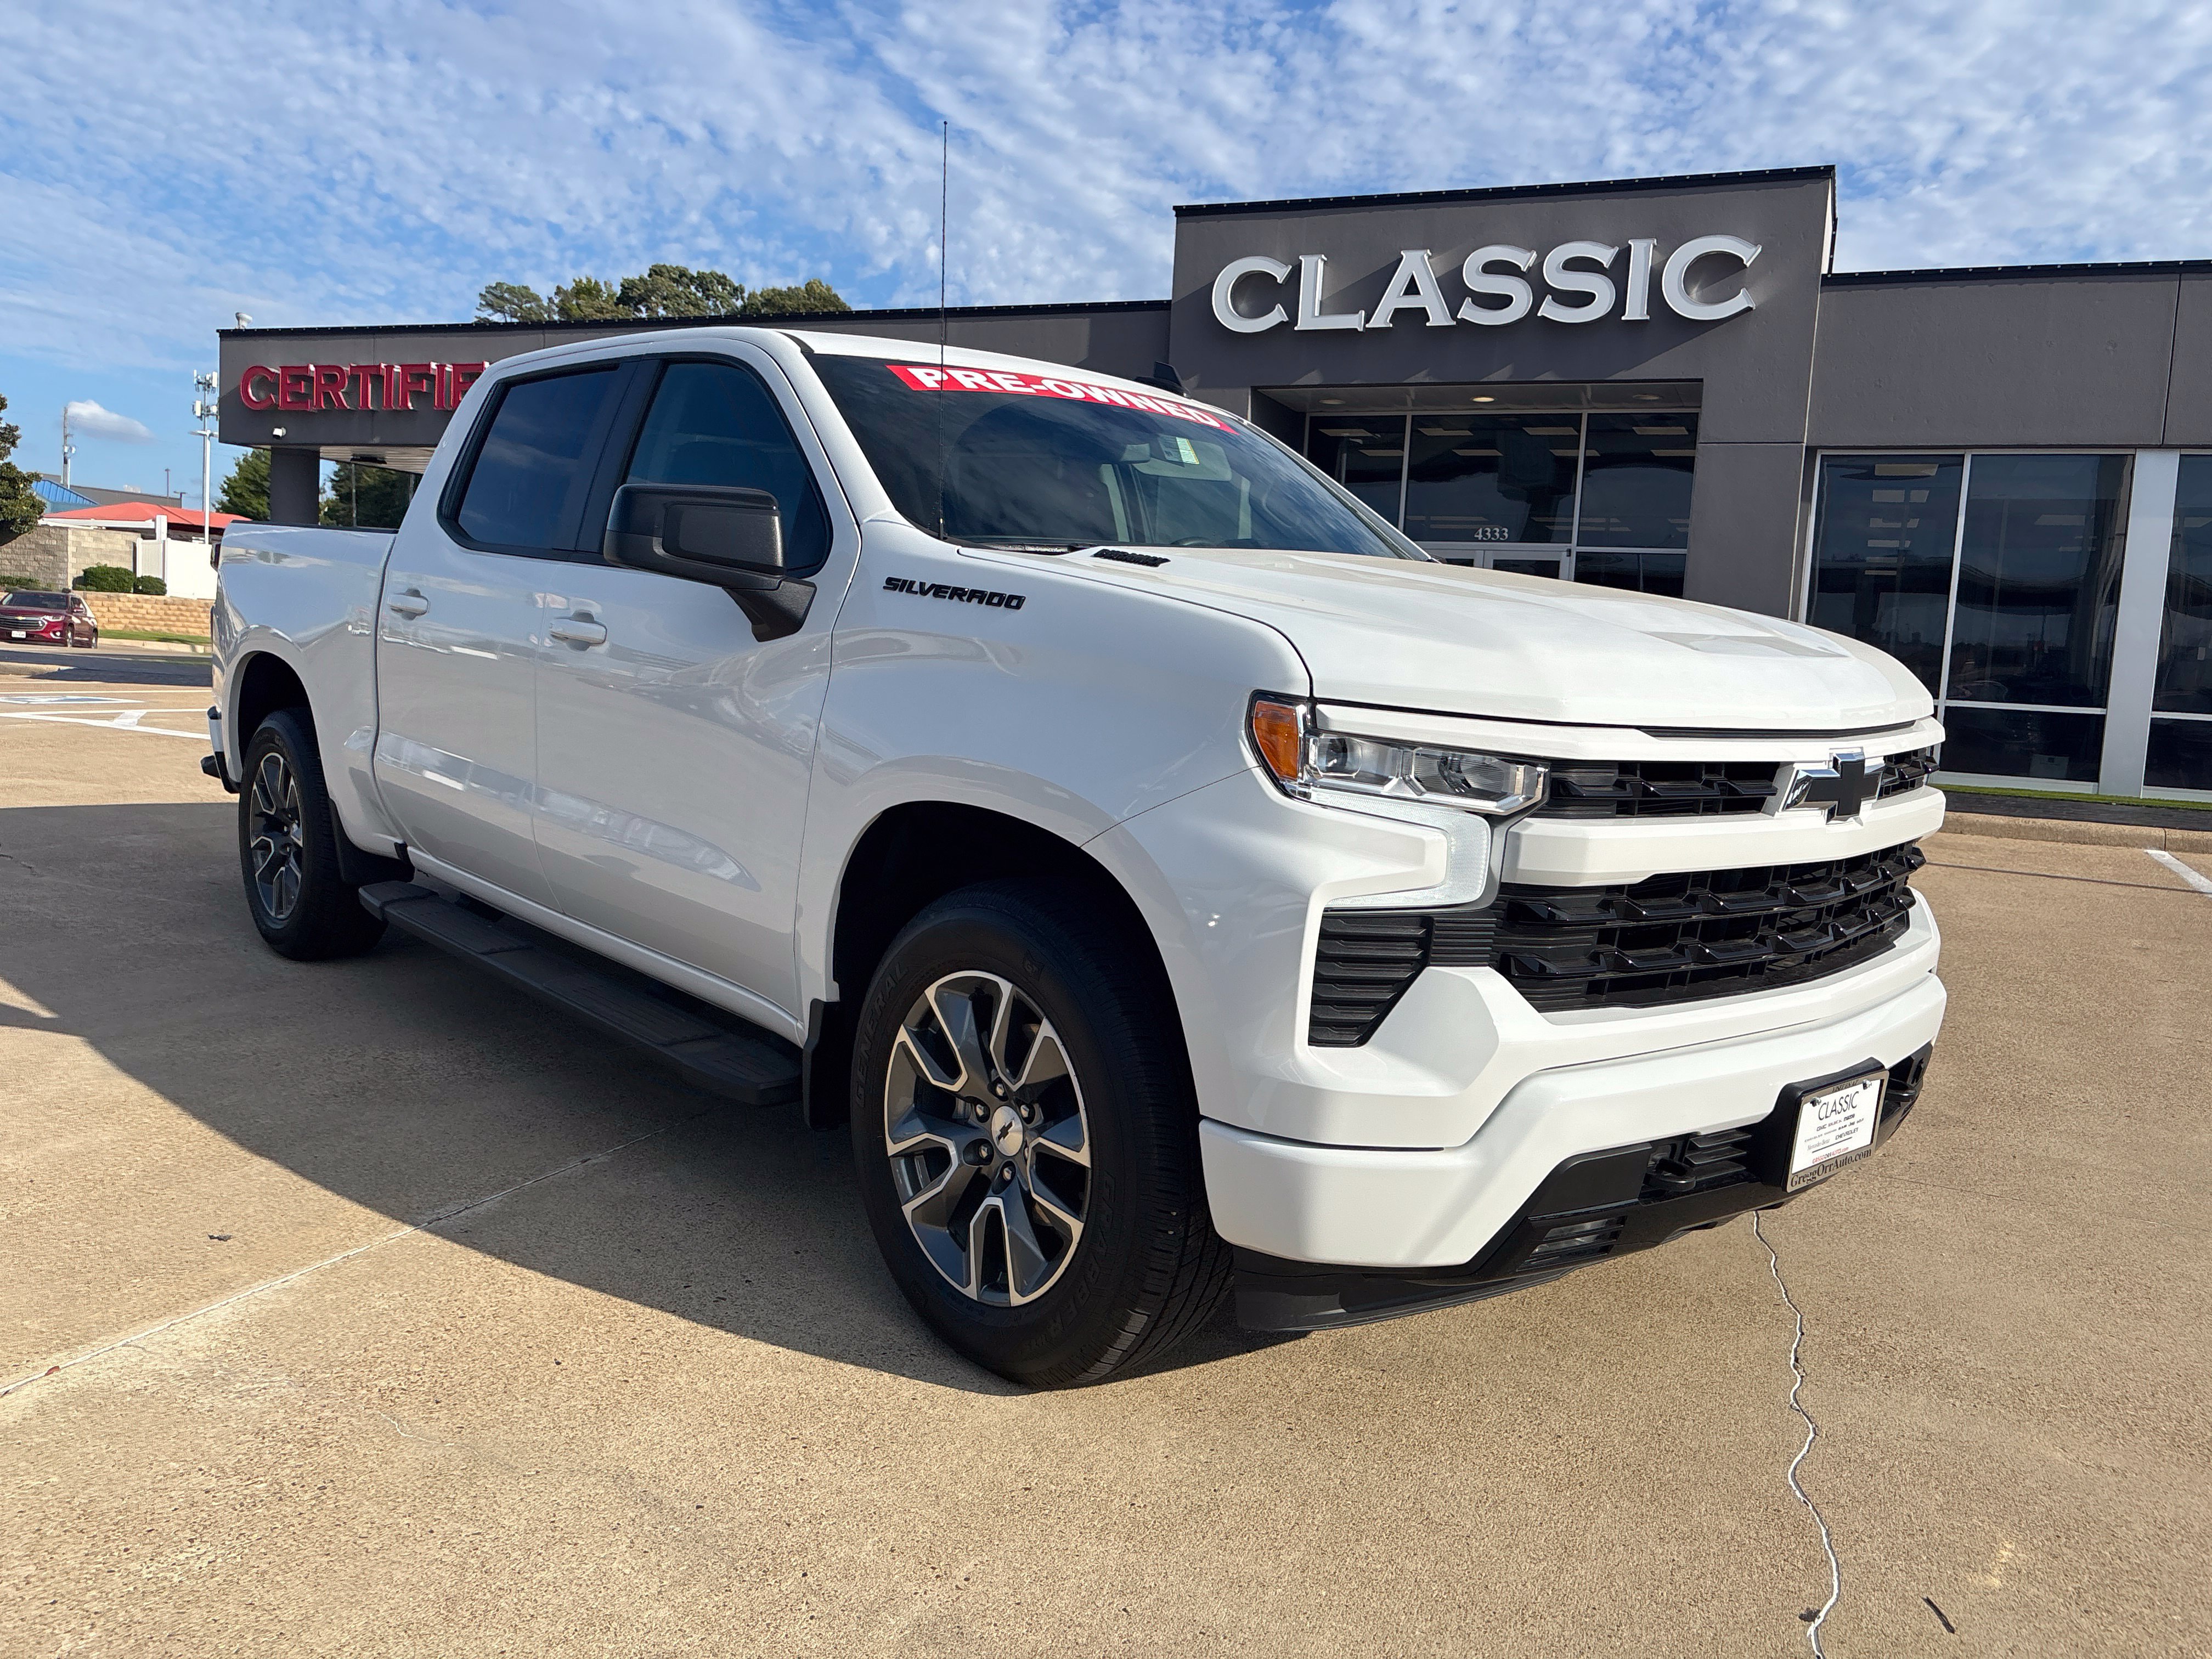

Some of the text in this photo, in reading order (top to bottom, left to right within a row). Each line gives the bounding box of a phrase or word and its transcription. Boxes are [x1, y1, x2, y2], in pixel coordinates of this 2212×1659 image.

[1211, 234, 1762, 334] CLASSIC
[906, 366, 1226, 428] PRE-OWNED
[1474, 527, 1509, 541] 4333
[883, 577, 1026, 610] SILVERADO
[855, 962, 909, 1108] GENERAL
[1818, 1091, 1859, 1121] CLASSIC
[1790, 1148, 1872, 1187] GreggOrrAuto.com
